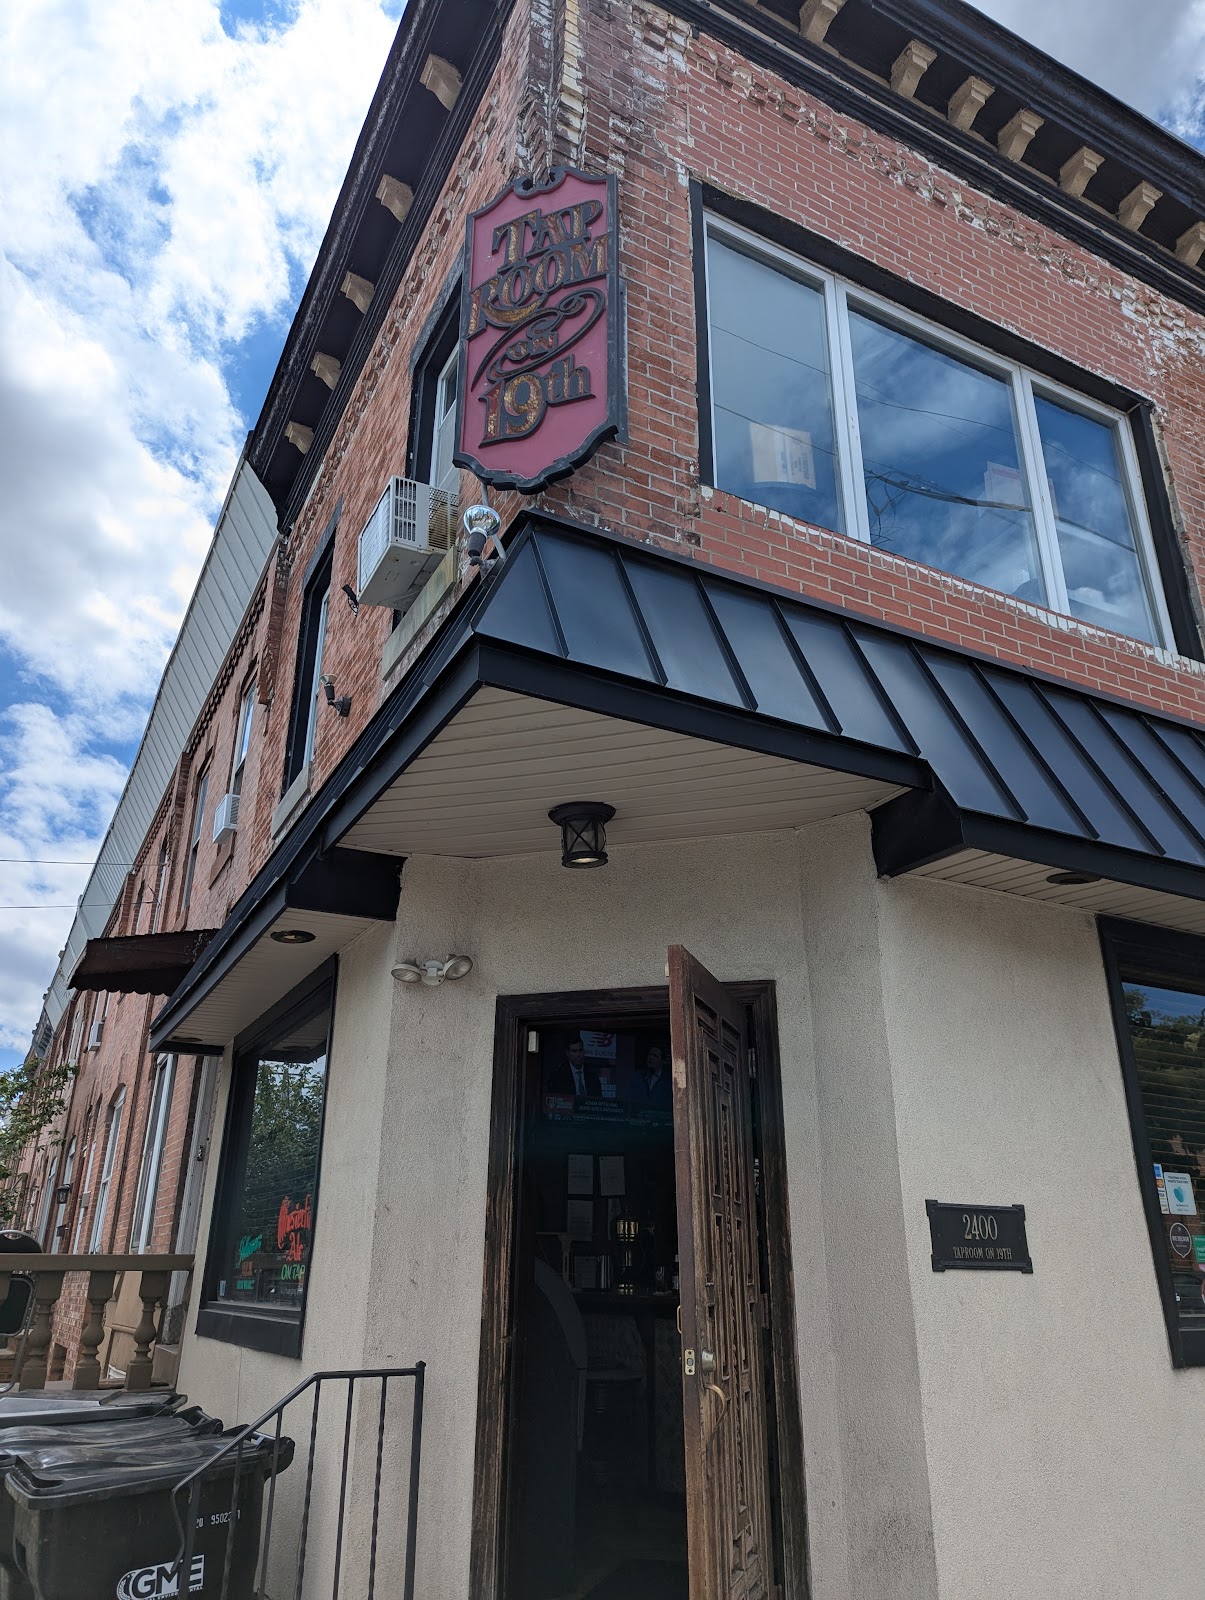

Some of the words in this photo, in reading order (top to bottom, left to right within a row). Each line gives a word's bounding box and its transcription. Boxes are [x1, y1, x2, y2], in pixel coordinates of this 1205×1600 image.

[492, 200, 603, 273] TAP
[465, 233, 613, 340] ROOM
[478, 354, 596, 448] 19th
[963, 1214, 997, 1240] 2400
[281, 1264, 292, 1280] ON
[953, 1246, 984, 1259] TAPROOM
[985, 1247, 995, 1259] ON
[996, 1248, 1013, 1260] 19TH
[132, 1557, 203, 1600] GME
